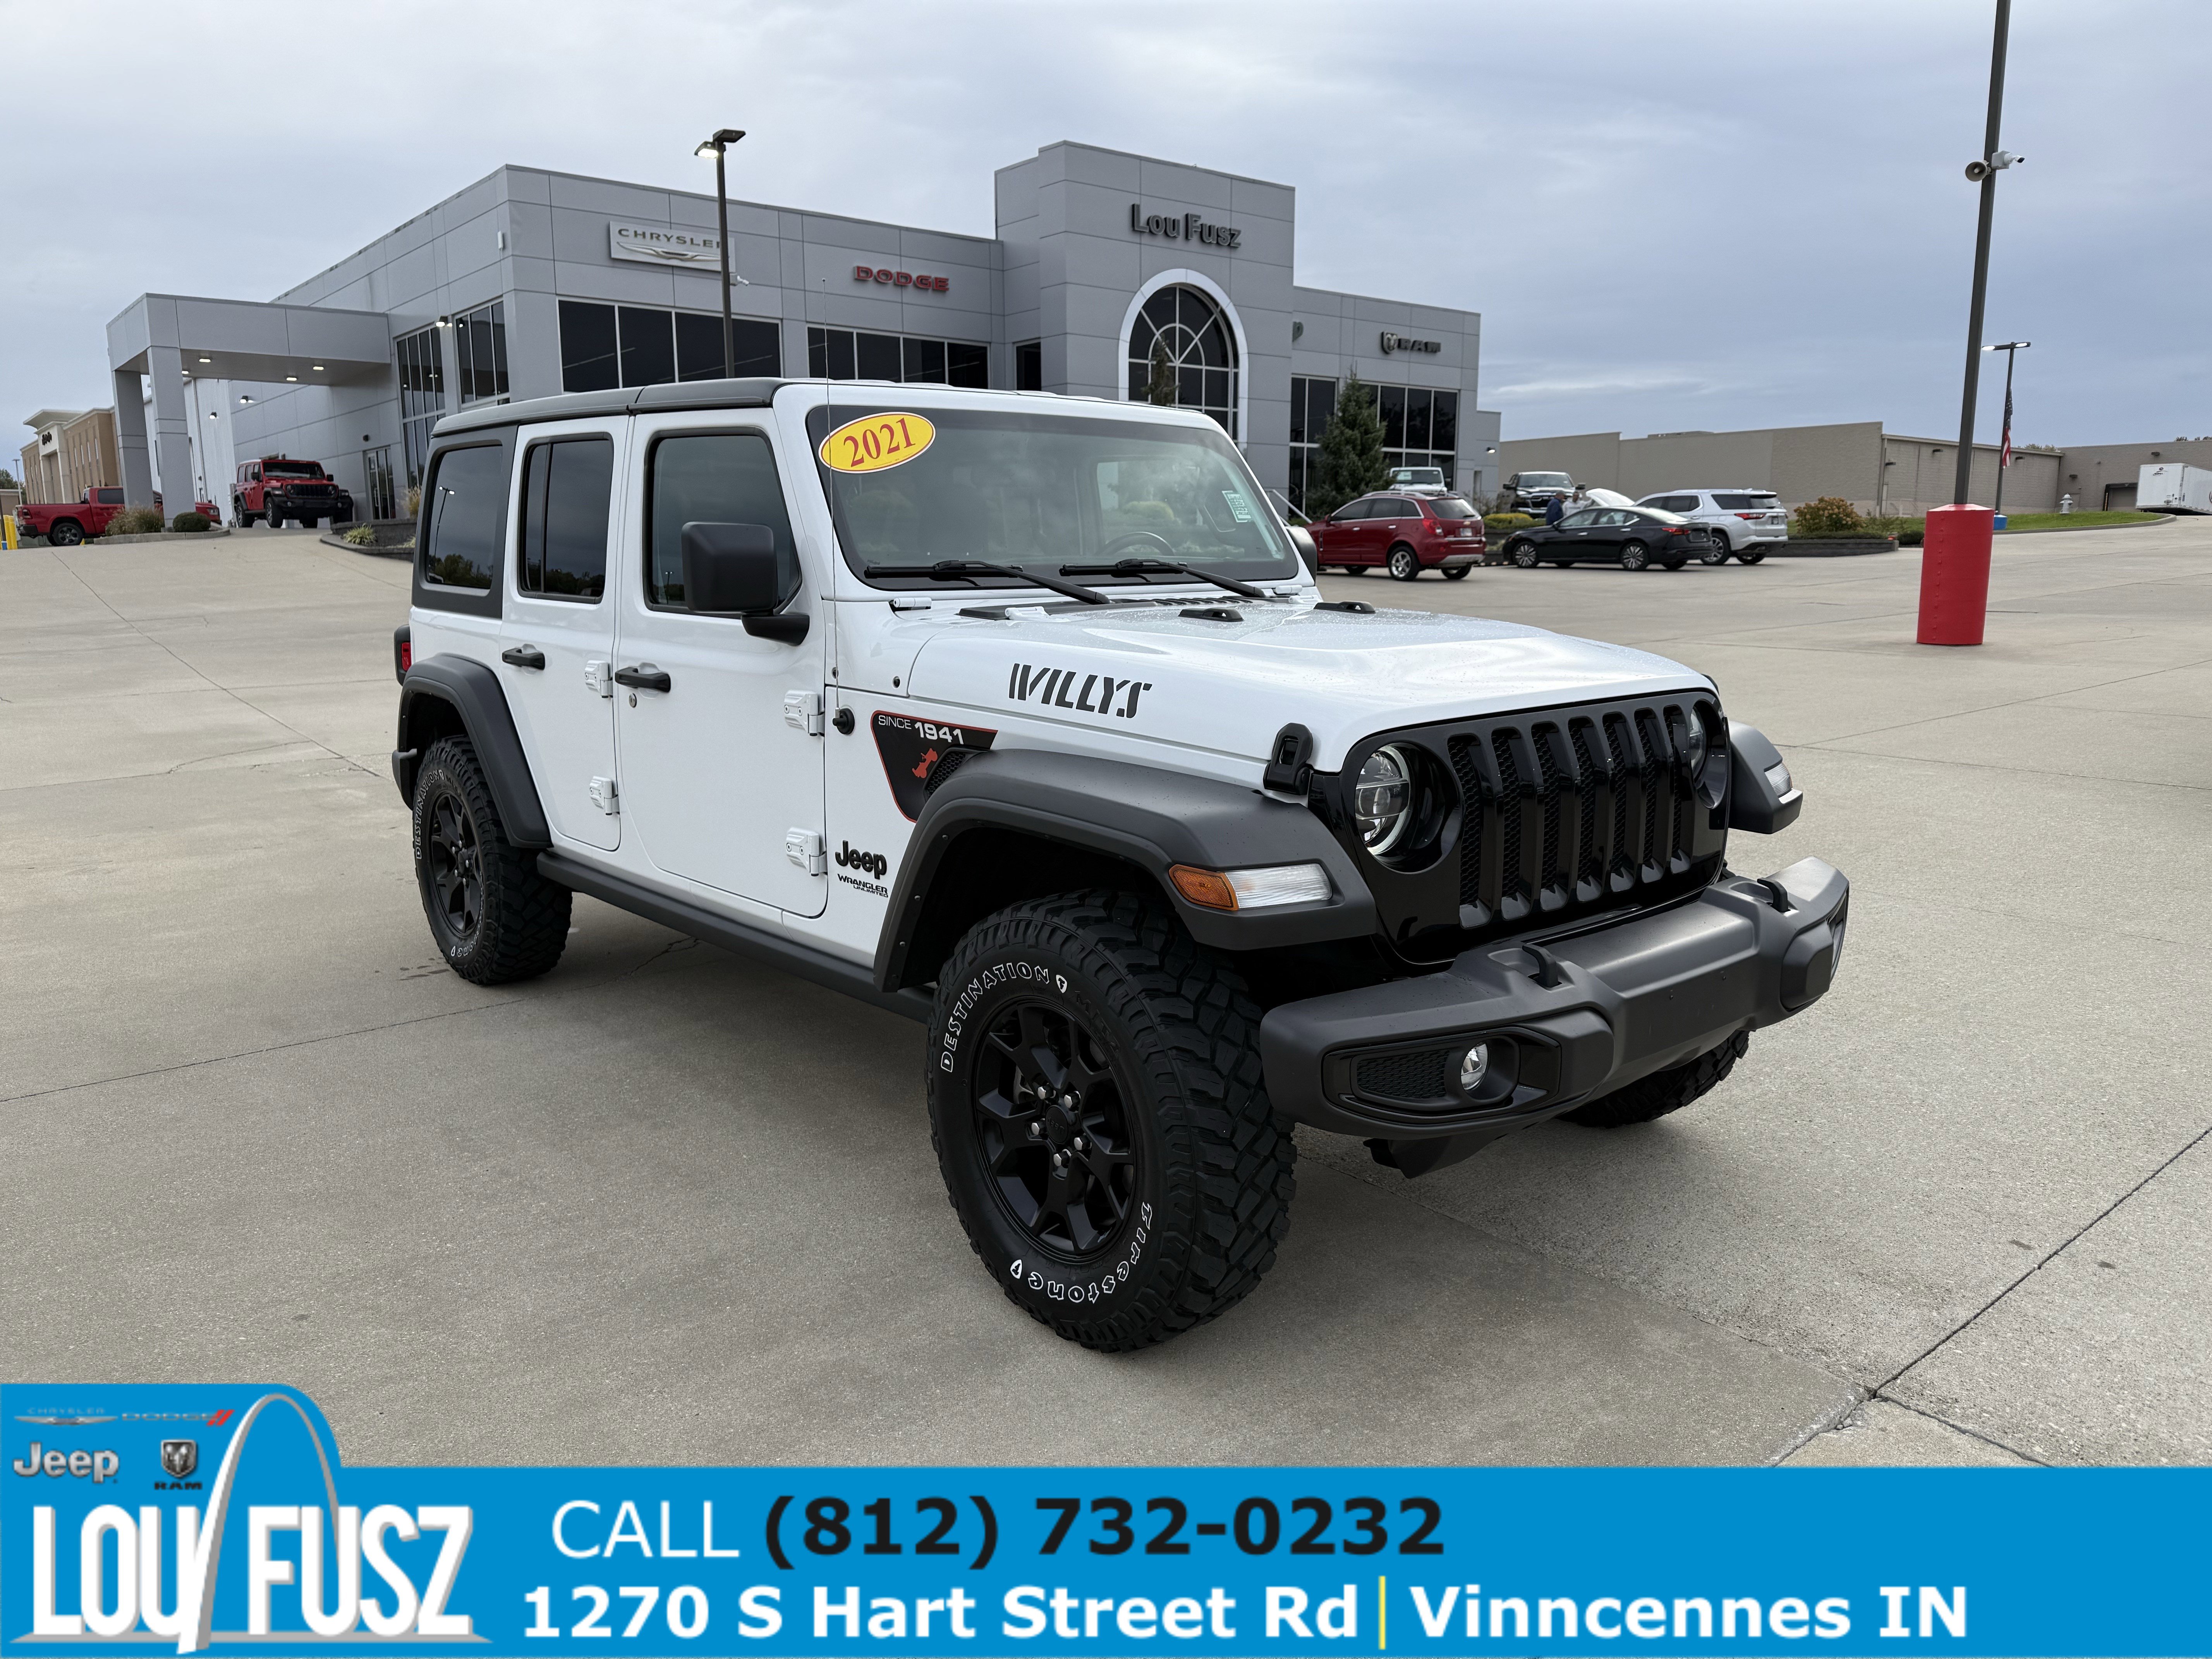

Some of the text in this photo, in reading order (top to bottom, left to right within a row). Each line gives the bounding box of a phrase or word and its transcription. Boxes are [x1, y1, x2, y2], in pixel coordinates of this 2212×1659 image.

[1131, 203, 1242, 248] Lou Fusz
[854, 265, 950, 292] DODGE
[1398, 338, 1441, 353] RAM
[843, 417, 916, 467] 2021
[1009, 663, 1152, 719] WILLYS
[878, 715, 964, 745] SINCE 1941
[415, 769, 440, 860] DESTINATION
[835, 840, 887, 880] Jeep
[837, 873, 888, 895] WRANGLER
[853, 884, 889, 898] UNLIMITED
[941, 962, 1050, 1073] DESTINATION
[1028, 1201, 1152, 1304] Firestone
